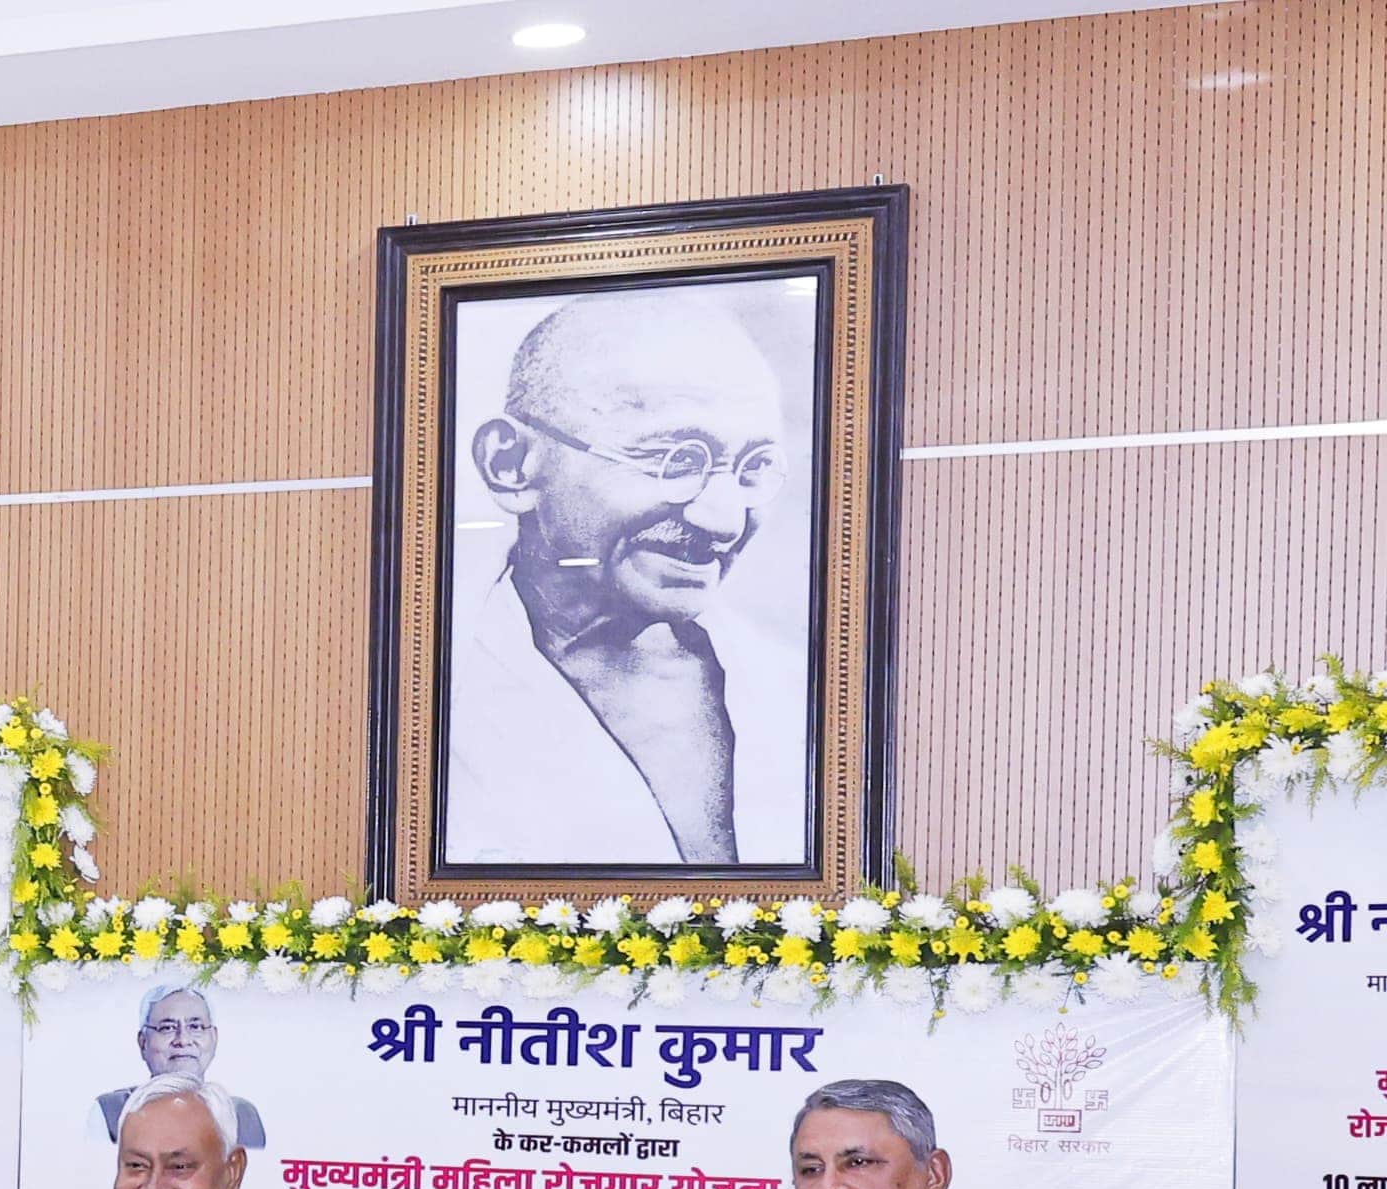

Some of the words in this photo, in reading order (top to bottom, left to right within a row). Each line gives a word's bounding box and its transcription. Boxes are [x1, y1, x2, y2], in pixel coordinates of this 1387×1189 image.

[1296, 891, 1357, 943] श्री
[368, 1004, 443, 1062] श्री
[456, 1005, 641, 1068] नीतीश
[655, 1025, 823, 1089] कुमार
[452, 1092, 539, 1118] माननीय
[546, 1096, 652, 1126] मुख्यमंत्री,
[659, 1098, 725, 1125] बिहार
[493, 1128, 515, 1151] के
[518, 1132, 631, 1155] कर-कमलों
[635, 1134, 680, 1160] द्वारा
[1058, 1140, 1112, 1153] सरकार
